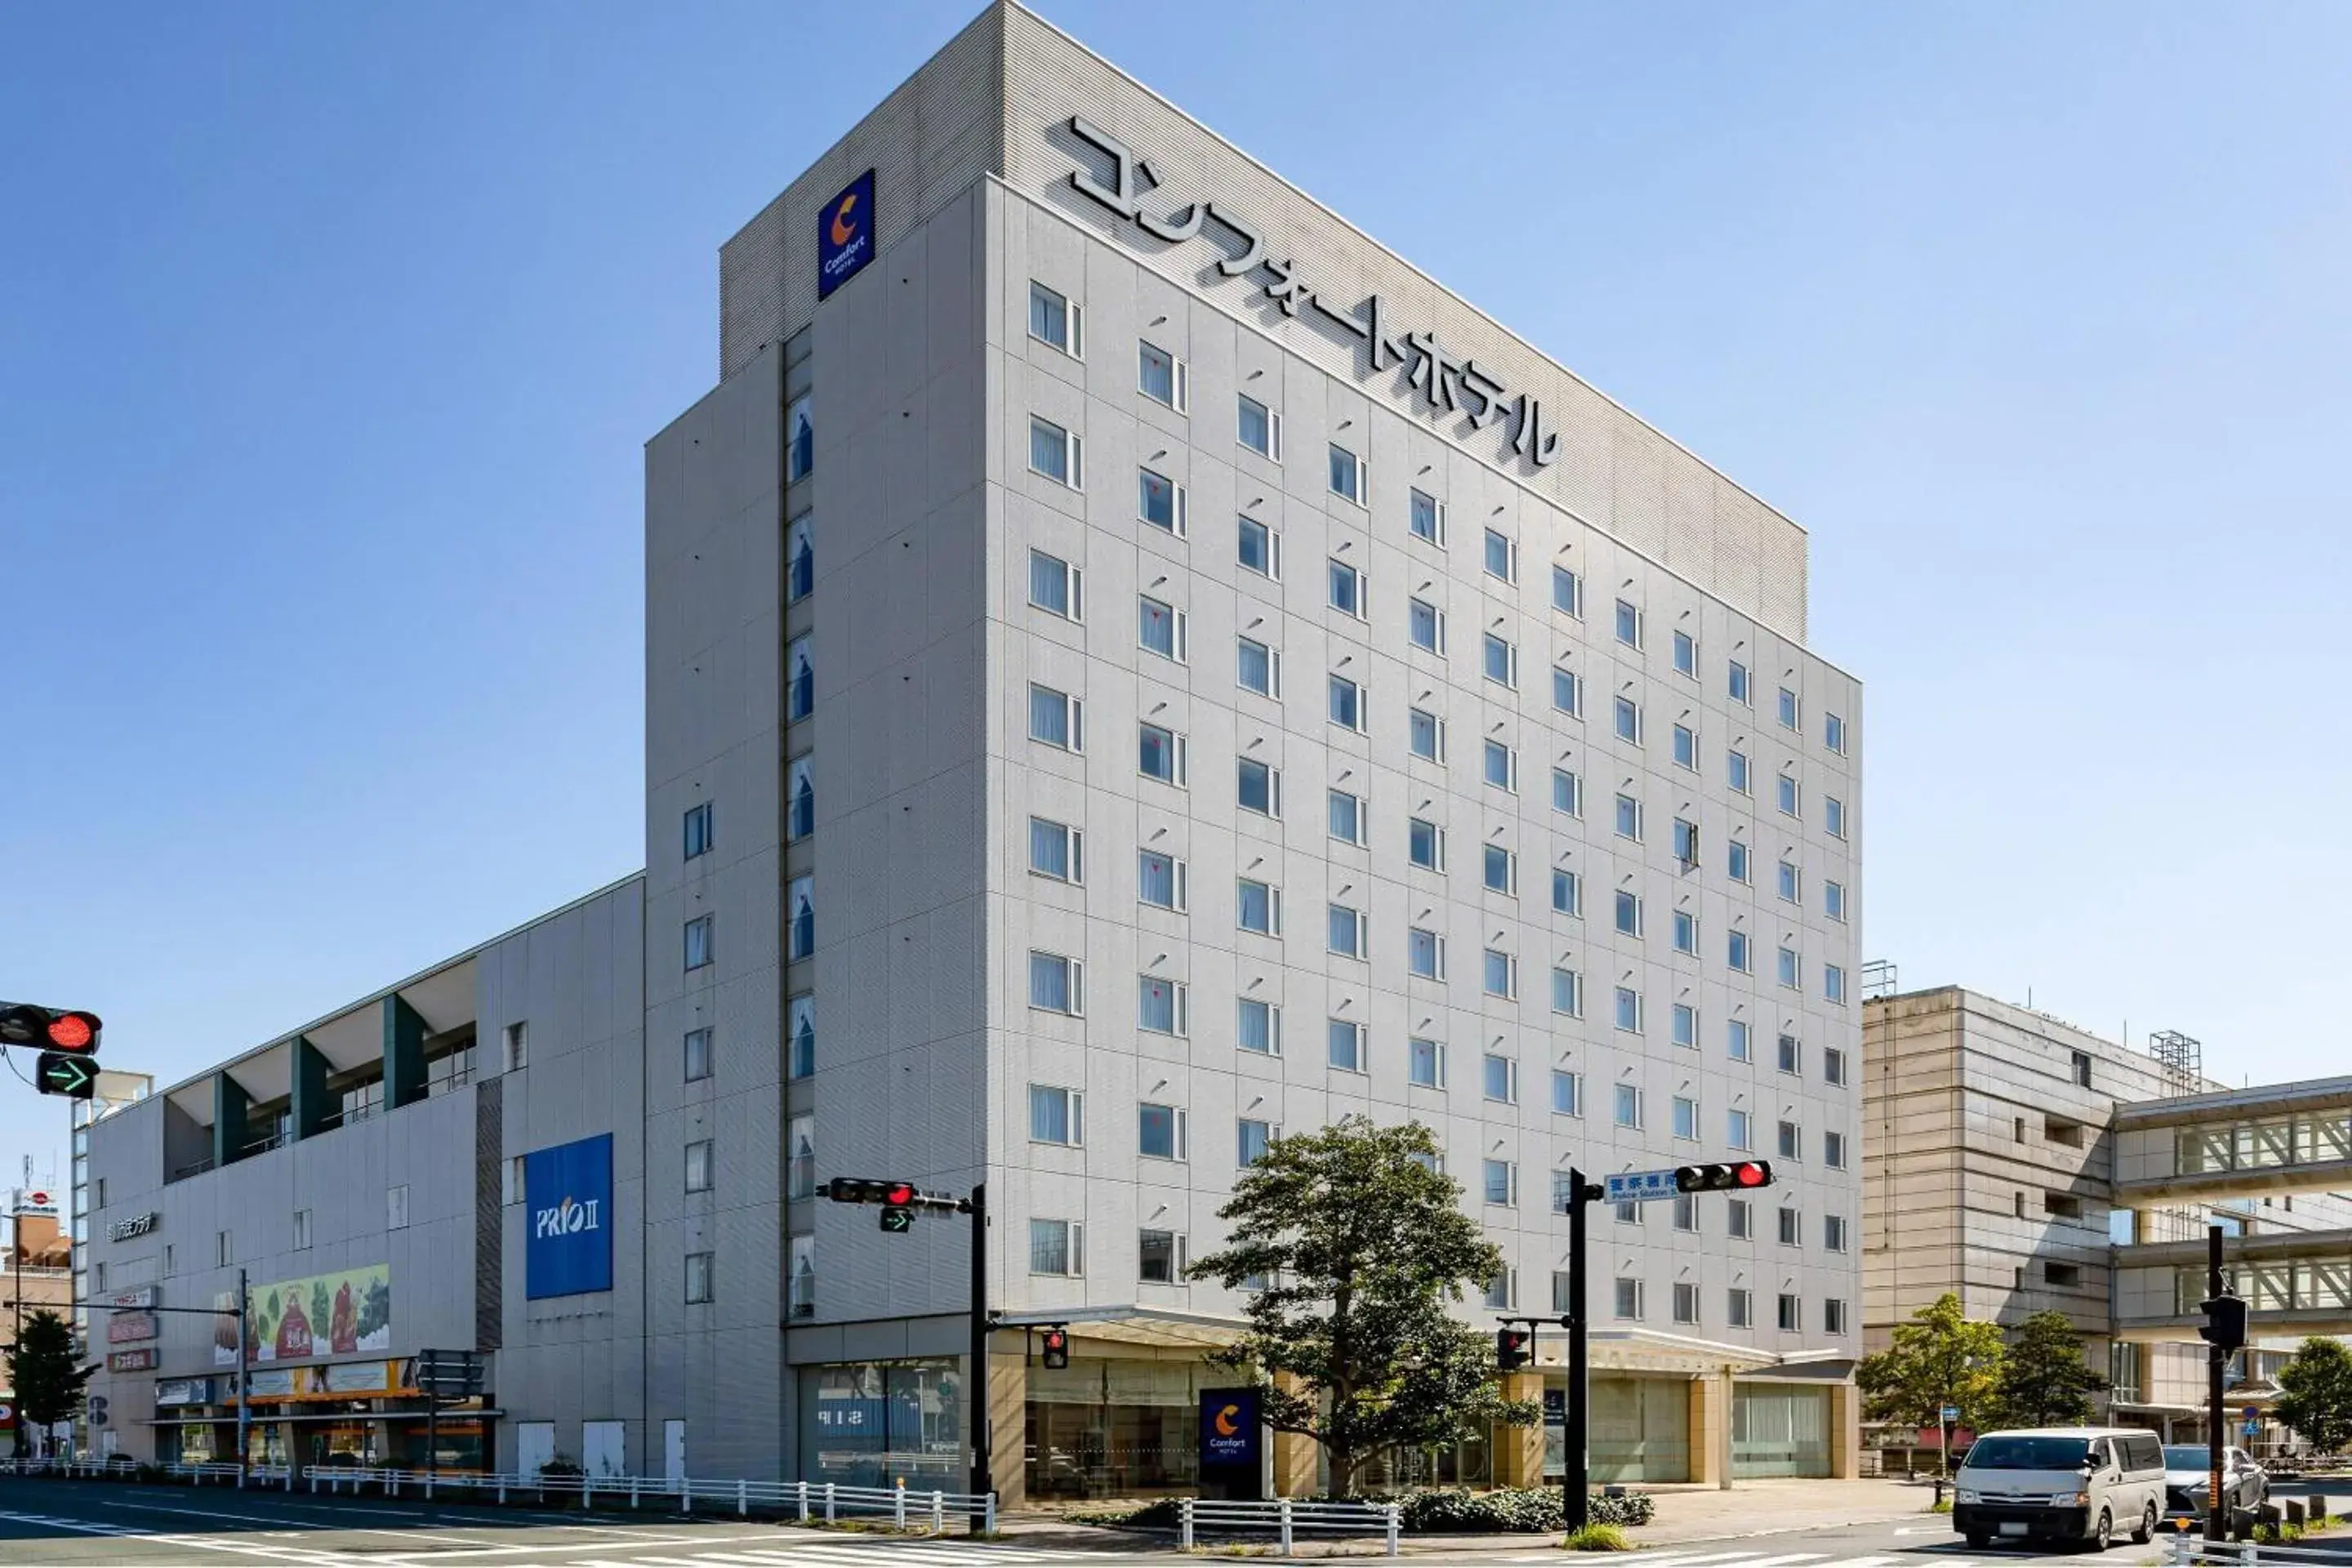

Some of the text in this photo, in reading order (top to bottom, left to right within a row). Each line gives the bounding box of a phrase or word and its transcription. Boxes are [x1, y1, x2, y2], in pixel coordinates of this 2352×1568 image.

[825, 235, 866, 274] Comfort
[835, 257, 856, 274] HOTEL
[1070, 114, 1562, 468] コンフォートホテル
[1639, 1188, 1667, 1198] Station
[1209, 1437, 1246, 1448] Comfort
